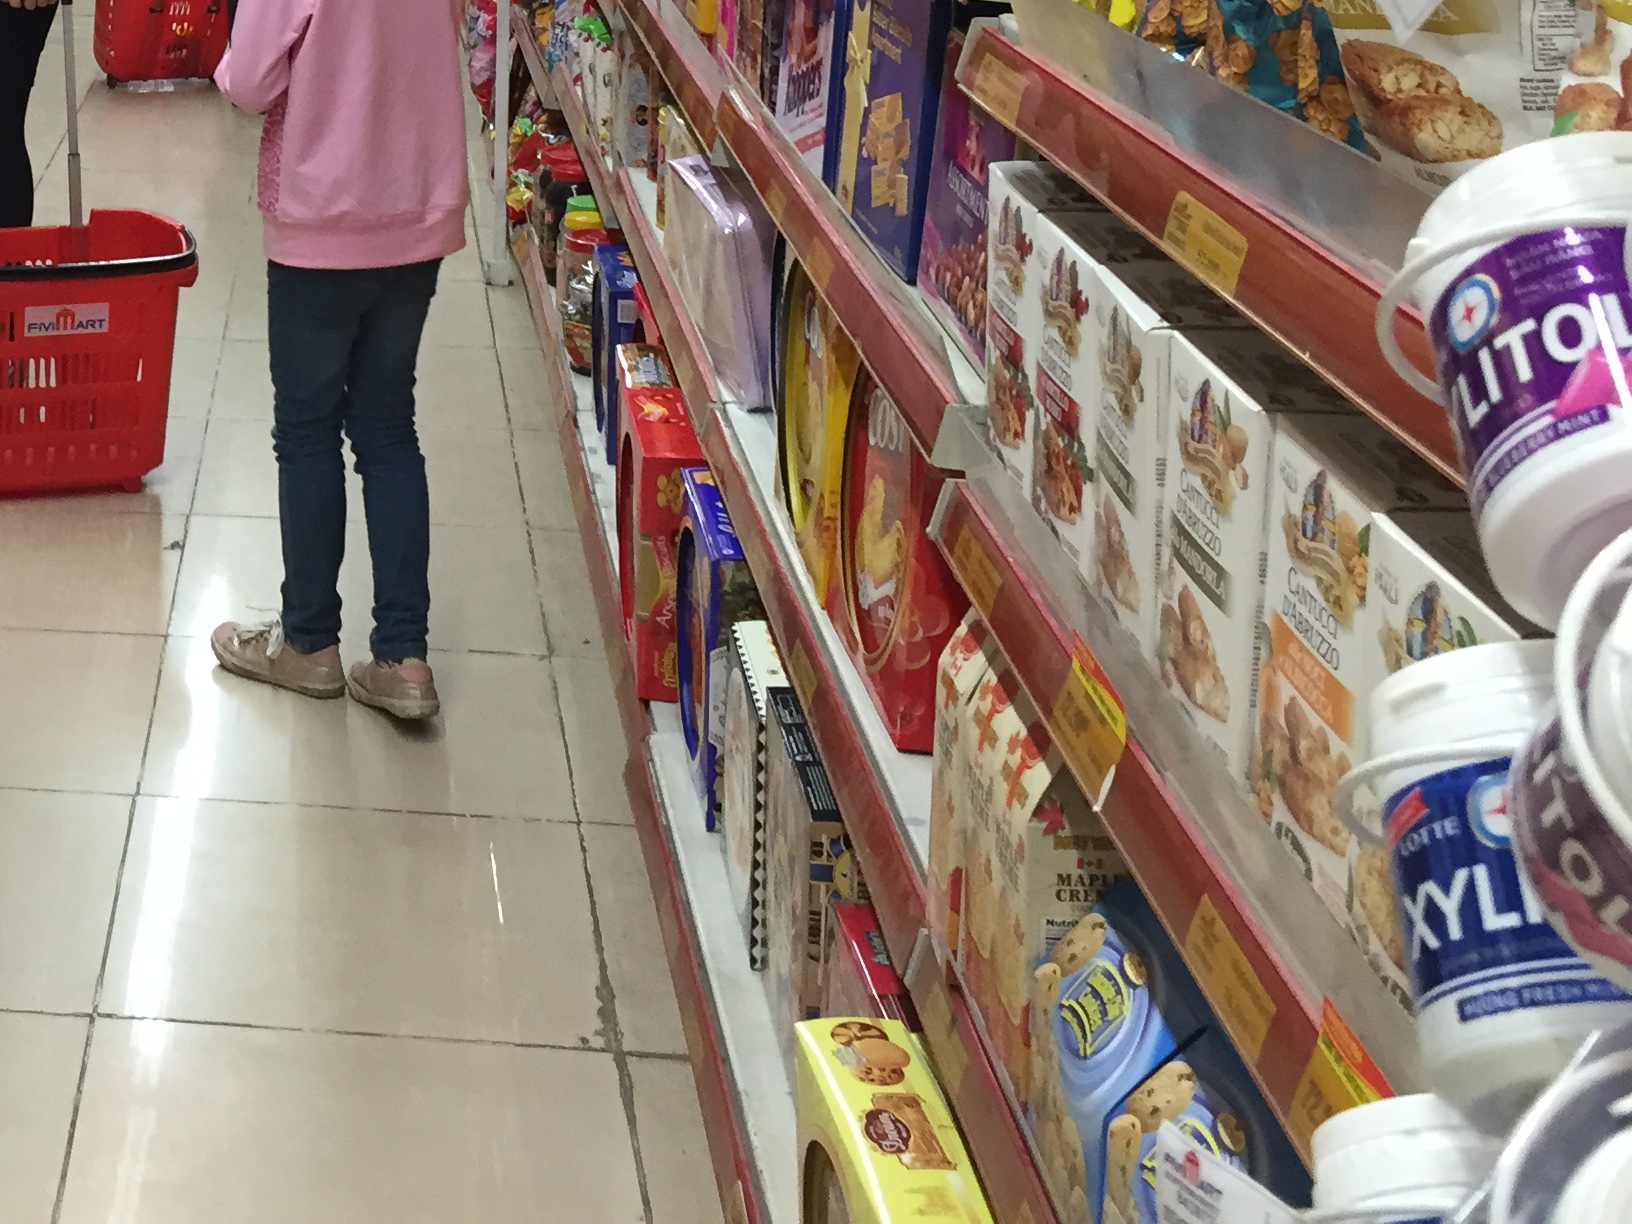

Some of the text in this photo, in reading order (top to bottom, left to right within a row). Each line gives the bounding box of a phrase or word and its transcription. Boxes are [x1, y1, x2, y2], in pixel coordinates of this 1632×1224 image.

[1452, 292, 1632, 428] LITOL
[1056, 873, 1116, 888] MAPL
[1055, 888, 1101, 903] CRE
[1402, 863, 1543, 961] XYLI
[1045, 918, 1080, 928] Nutrit
